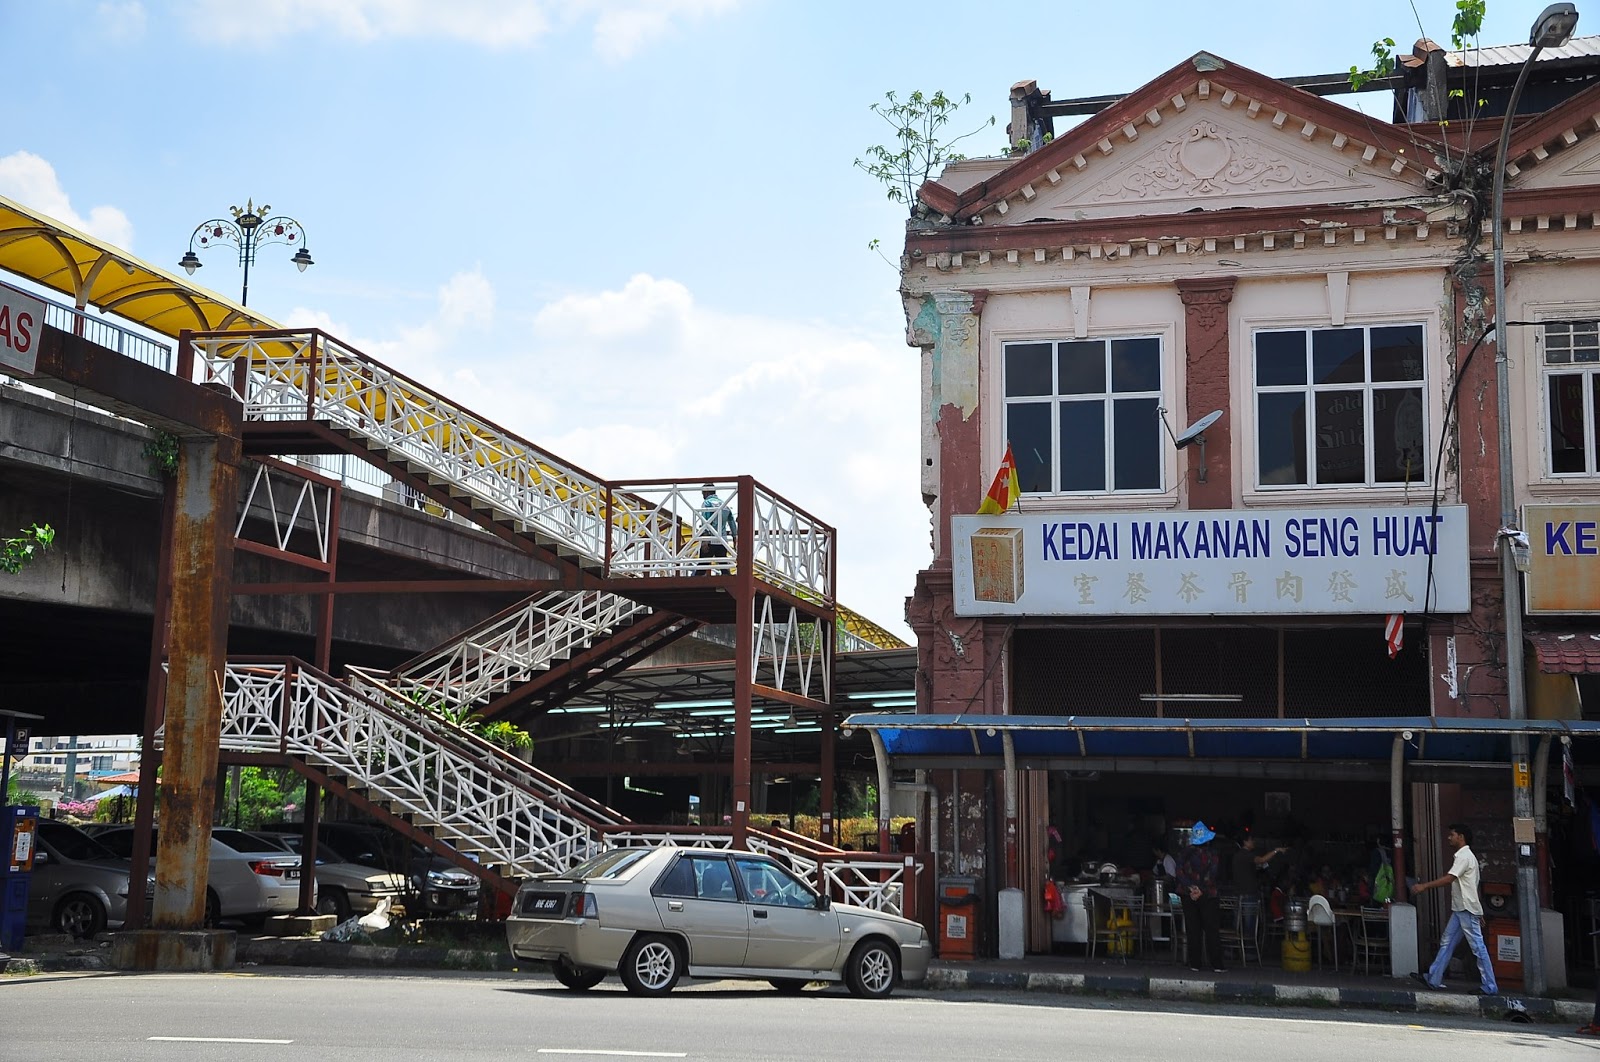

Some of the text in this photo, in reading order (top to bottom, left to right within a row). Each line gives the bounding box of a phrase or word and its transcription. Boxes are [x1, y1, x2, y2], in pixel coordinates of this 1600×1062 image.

[0, 304, 33, 353] AS
[1042, 515, 1444, 561] KEDAI MAKANAN SENG HUAT
[1545, 521, 1598, 556] KE
